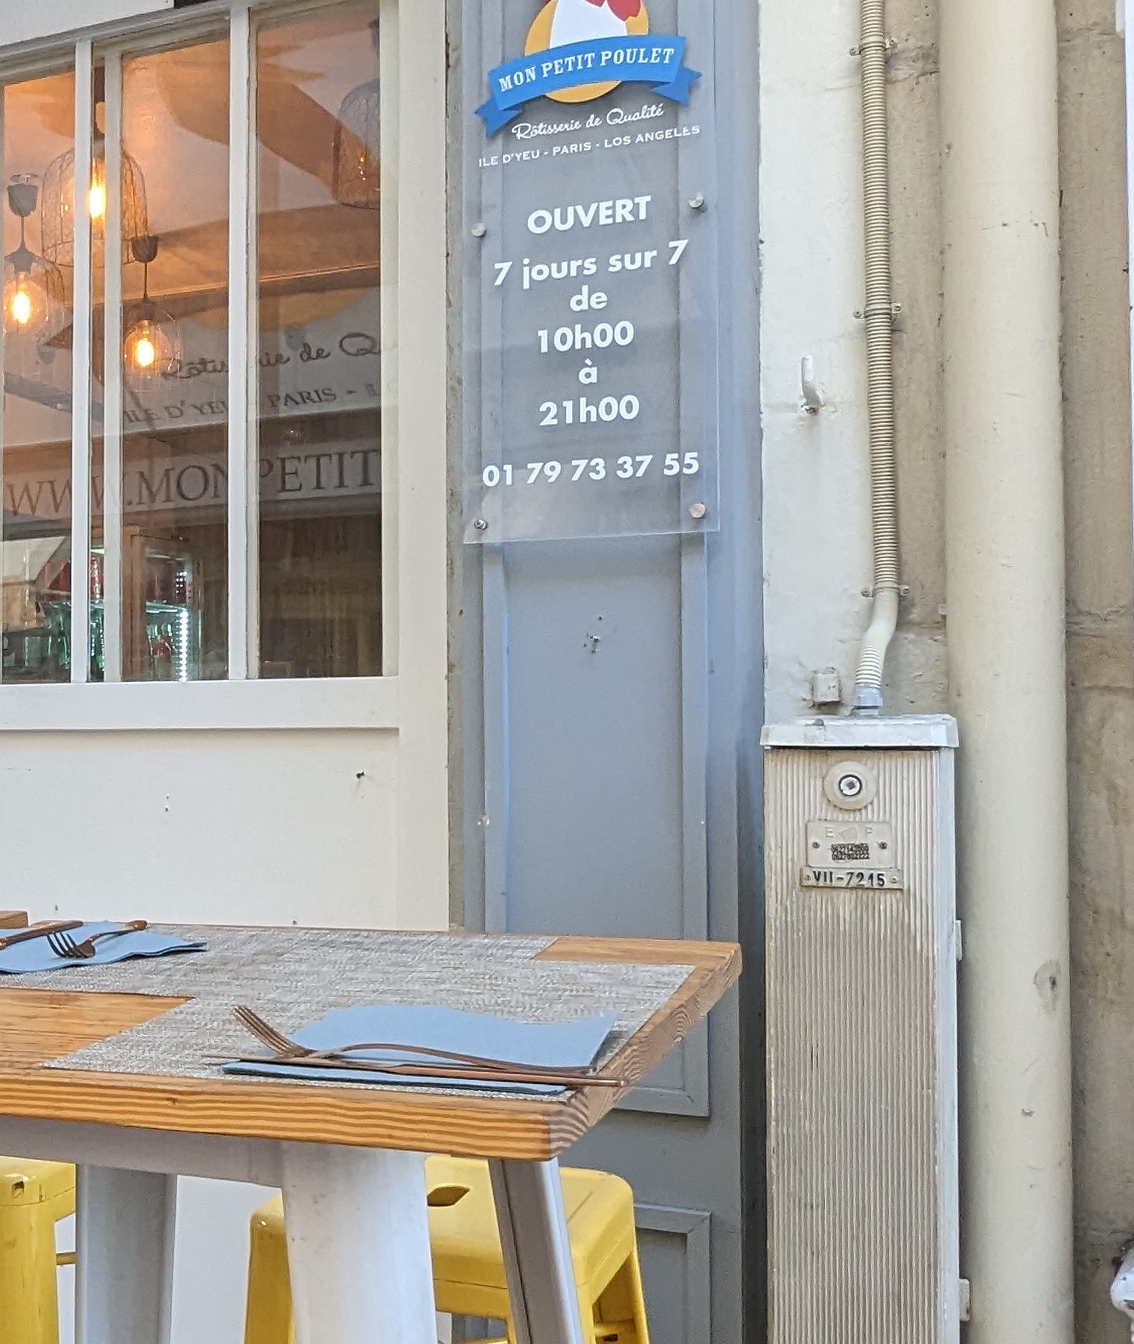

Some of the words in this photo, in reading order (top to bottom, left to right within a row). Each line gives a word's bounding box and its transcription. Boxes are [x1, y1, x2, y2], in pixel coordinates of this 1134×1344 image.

[498, 65, 536, 92] MON
[542, 53, 596, 78] PETIT
[600, 47, 675, 67] POULET
[511, 118, 582, 140] Rôtisserie
[585, 113, 602, 128] de
[606, 103, 665, 126] Qualité
[479, 156, 498, 168] ILE
[503, 149, 540, 164] D'YEU
[552, 141, 592, 156] PARIS
[604, 136, 632, 148] LOS
[635, 125, 701, 143] ANGELES
[527, 195, 652, 235] OUVERT
[493, 261, 512, 287] 7
[522, 257, 597, 289] jours
[608, 249, 658, 273] sur
[668, 239, 689, 266] 7
[570, 285, 608, 312] de
[299, 342, 331, 362] de
[537, 321, 635, 353] 10h00
[578, 359, 598, 384] à
[164, 399, 228, 419] D'YE
[268, 387, 337, 407] PARIS
[539, 395, 640, 426] 21h00
[482, 464, 512, 487] 01
[527, 461, 561, 485] 79
[570, 458, 606, 481] 73
[616, 455, 653, 478] 37
[663, 452, 700, 476] 55
[813, 870, 886, 887] VII-7215
